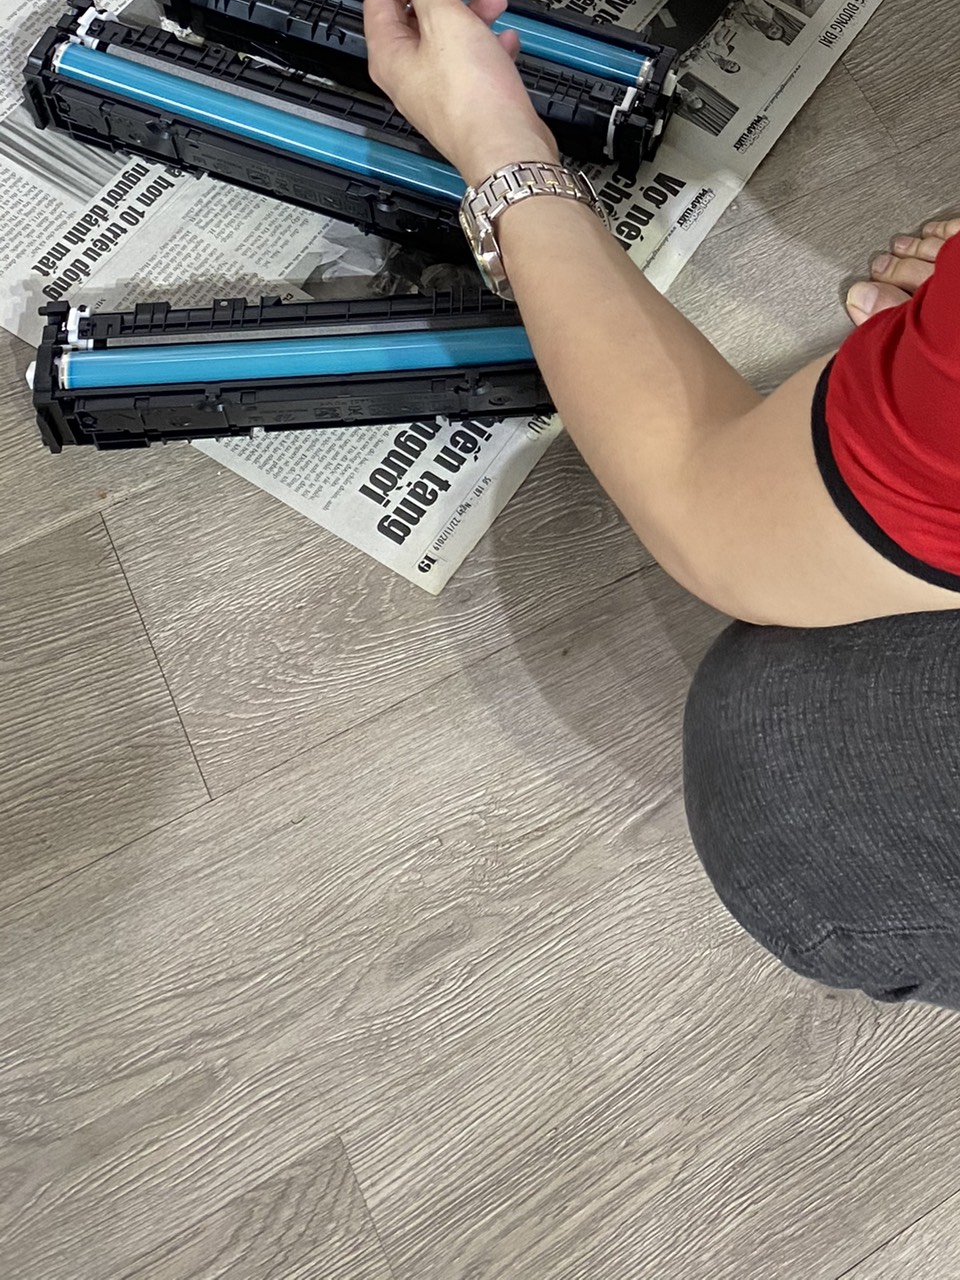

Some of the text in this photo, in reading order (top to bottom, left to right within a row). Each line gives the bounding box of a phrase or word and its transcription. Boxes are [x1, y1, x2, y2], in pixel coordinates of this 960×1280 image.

[639, 171, 687, 212] Vợ
[32, 162, 150, 278] người đánh mất
[42, 174, 175, 302] hơn 10 triệu đồng
[359, 422, 441, 508] người
[377, 475, 452, 545] tạng
[432, 515, 461, 552] 22/11/2019
[455, 499, 471, 517] Ngày
[417, 554, 436, 574] 19
